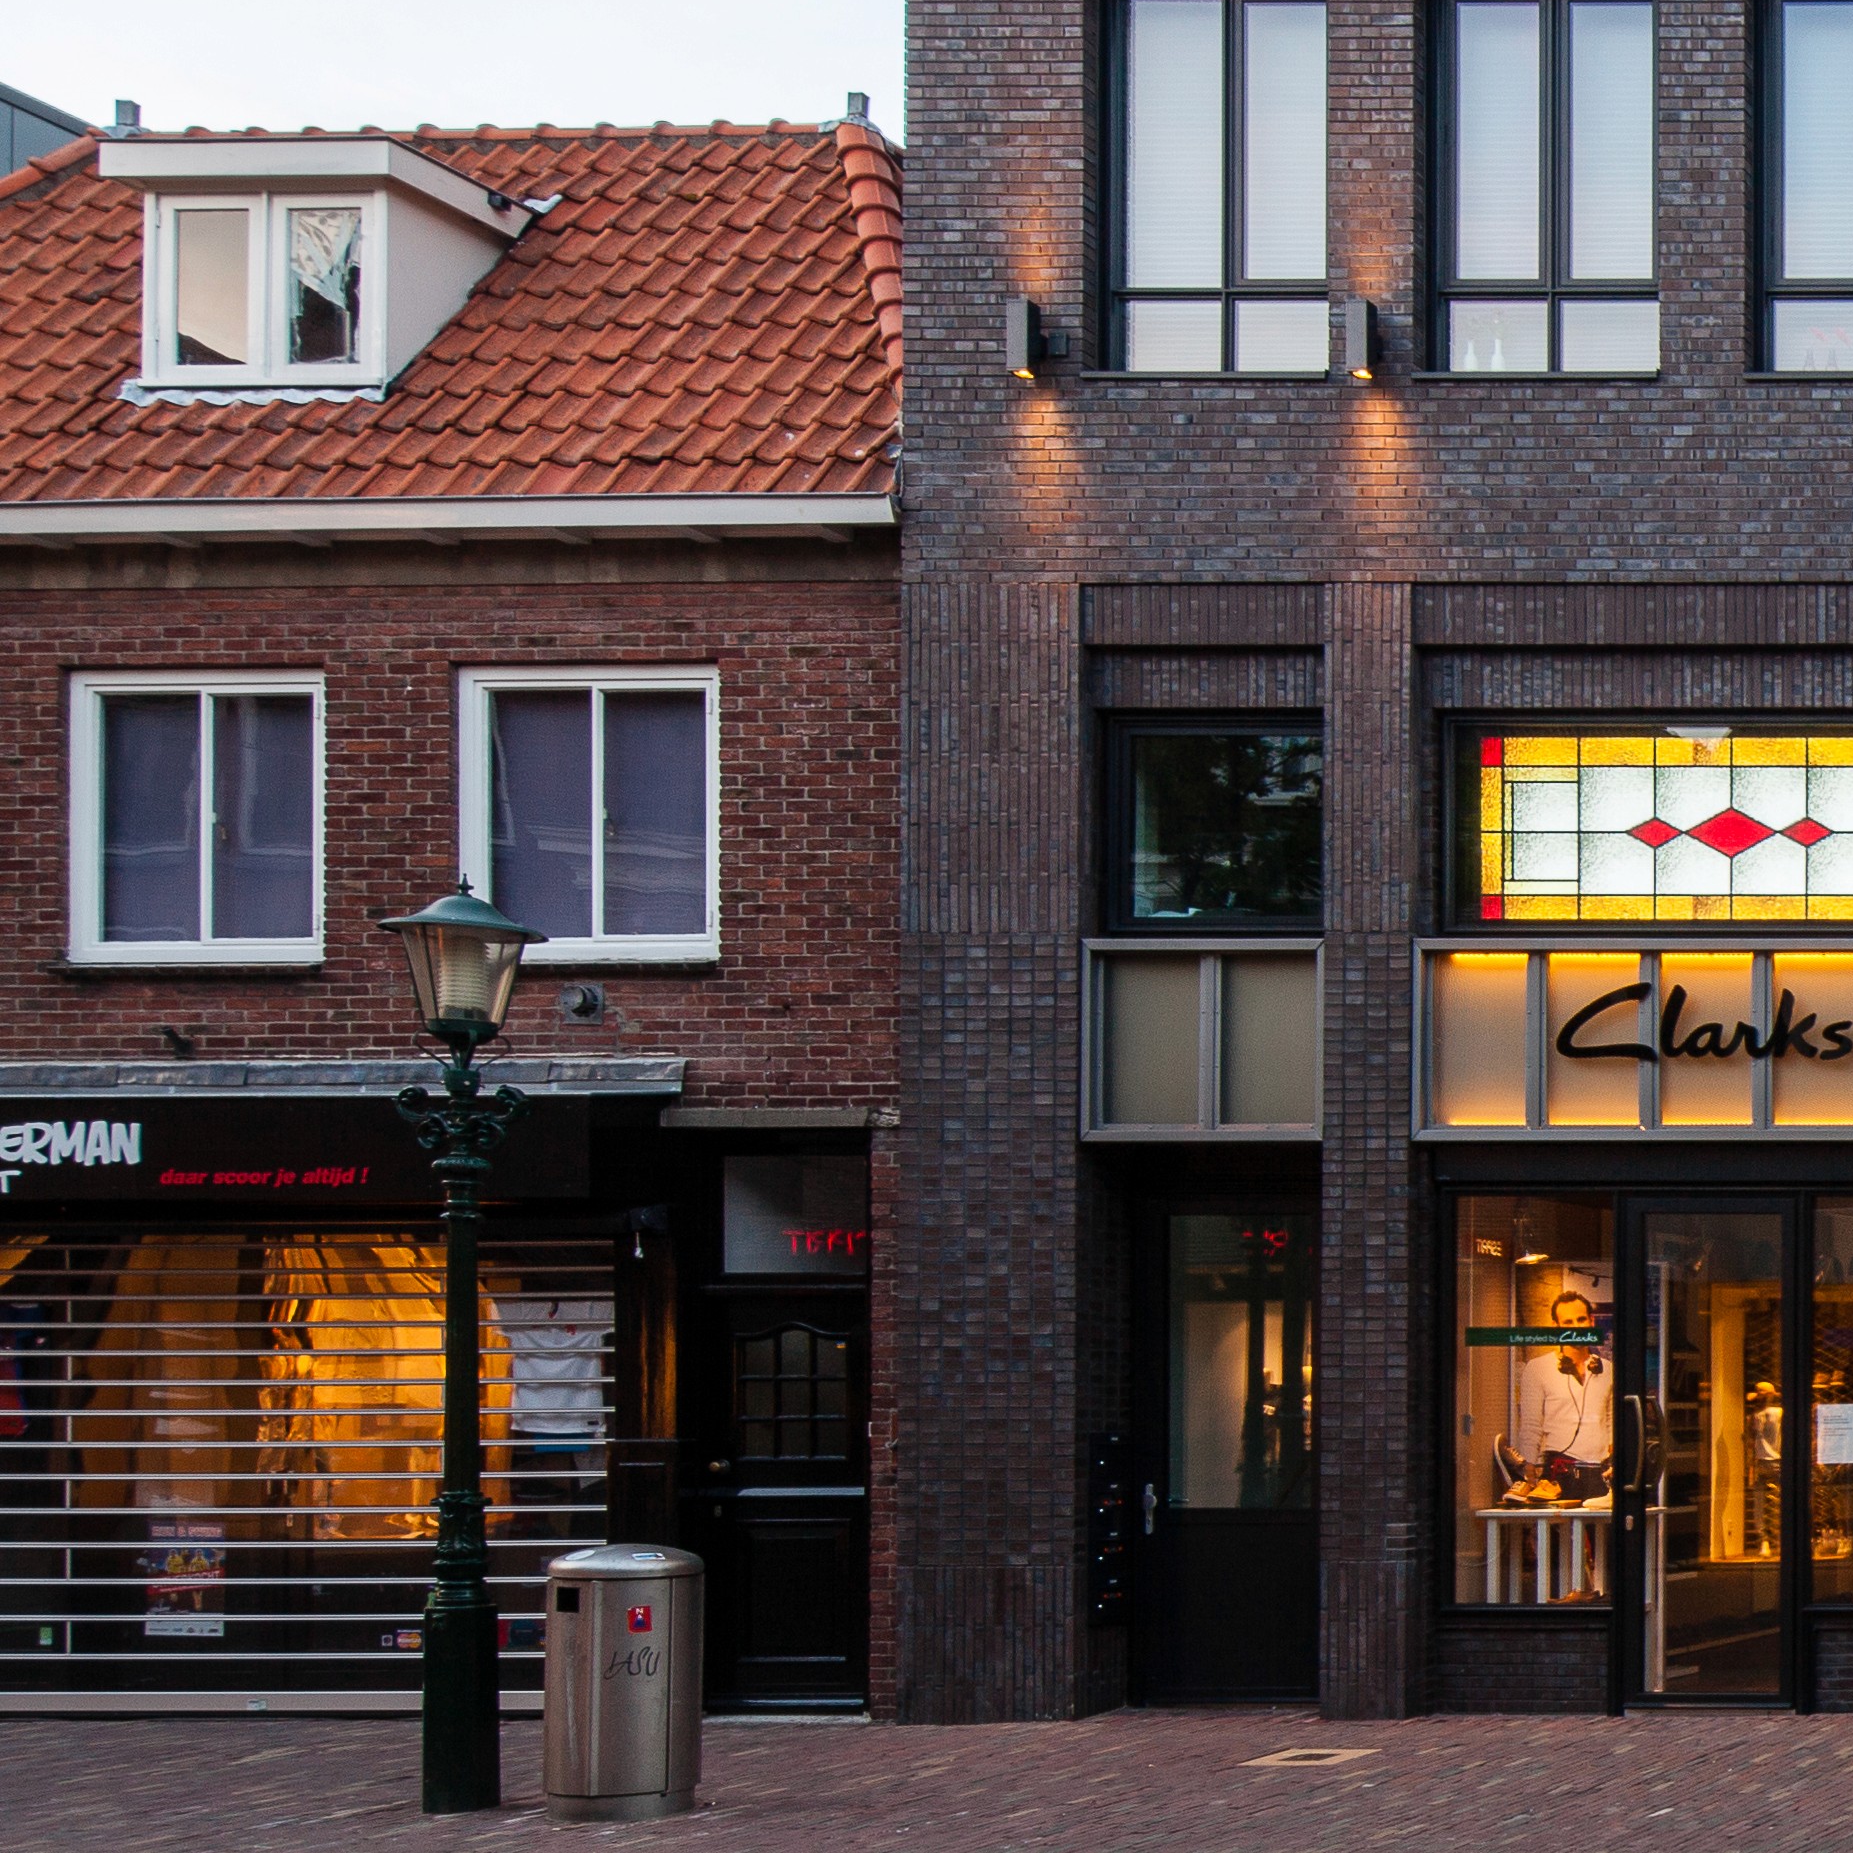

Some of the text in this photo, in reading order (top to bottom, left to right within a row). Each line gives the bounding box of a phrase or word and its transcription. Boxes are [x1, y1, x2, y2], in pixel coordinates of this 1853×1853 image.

[160, 1168, 208, 1185] daar
[213, 1170, 270, 1185] scoor
[274, 1169, 296, 1188] je
[302, 1167, 355, 1188] altijd
[1525, 1334, 1547, 1345] styled
[1549, 1334, 1558, 1345] by
[1559, 1331, 1598, 1343] Clarks
